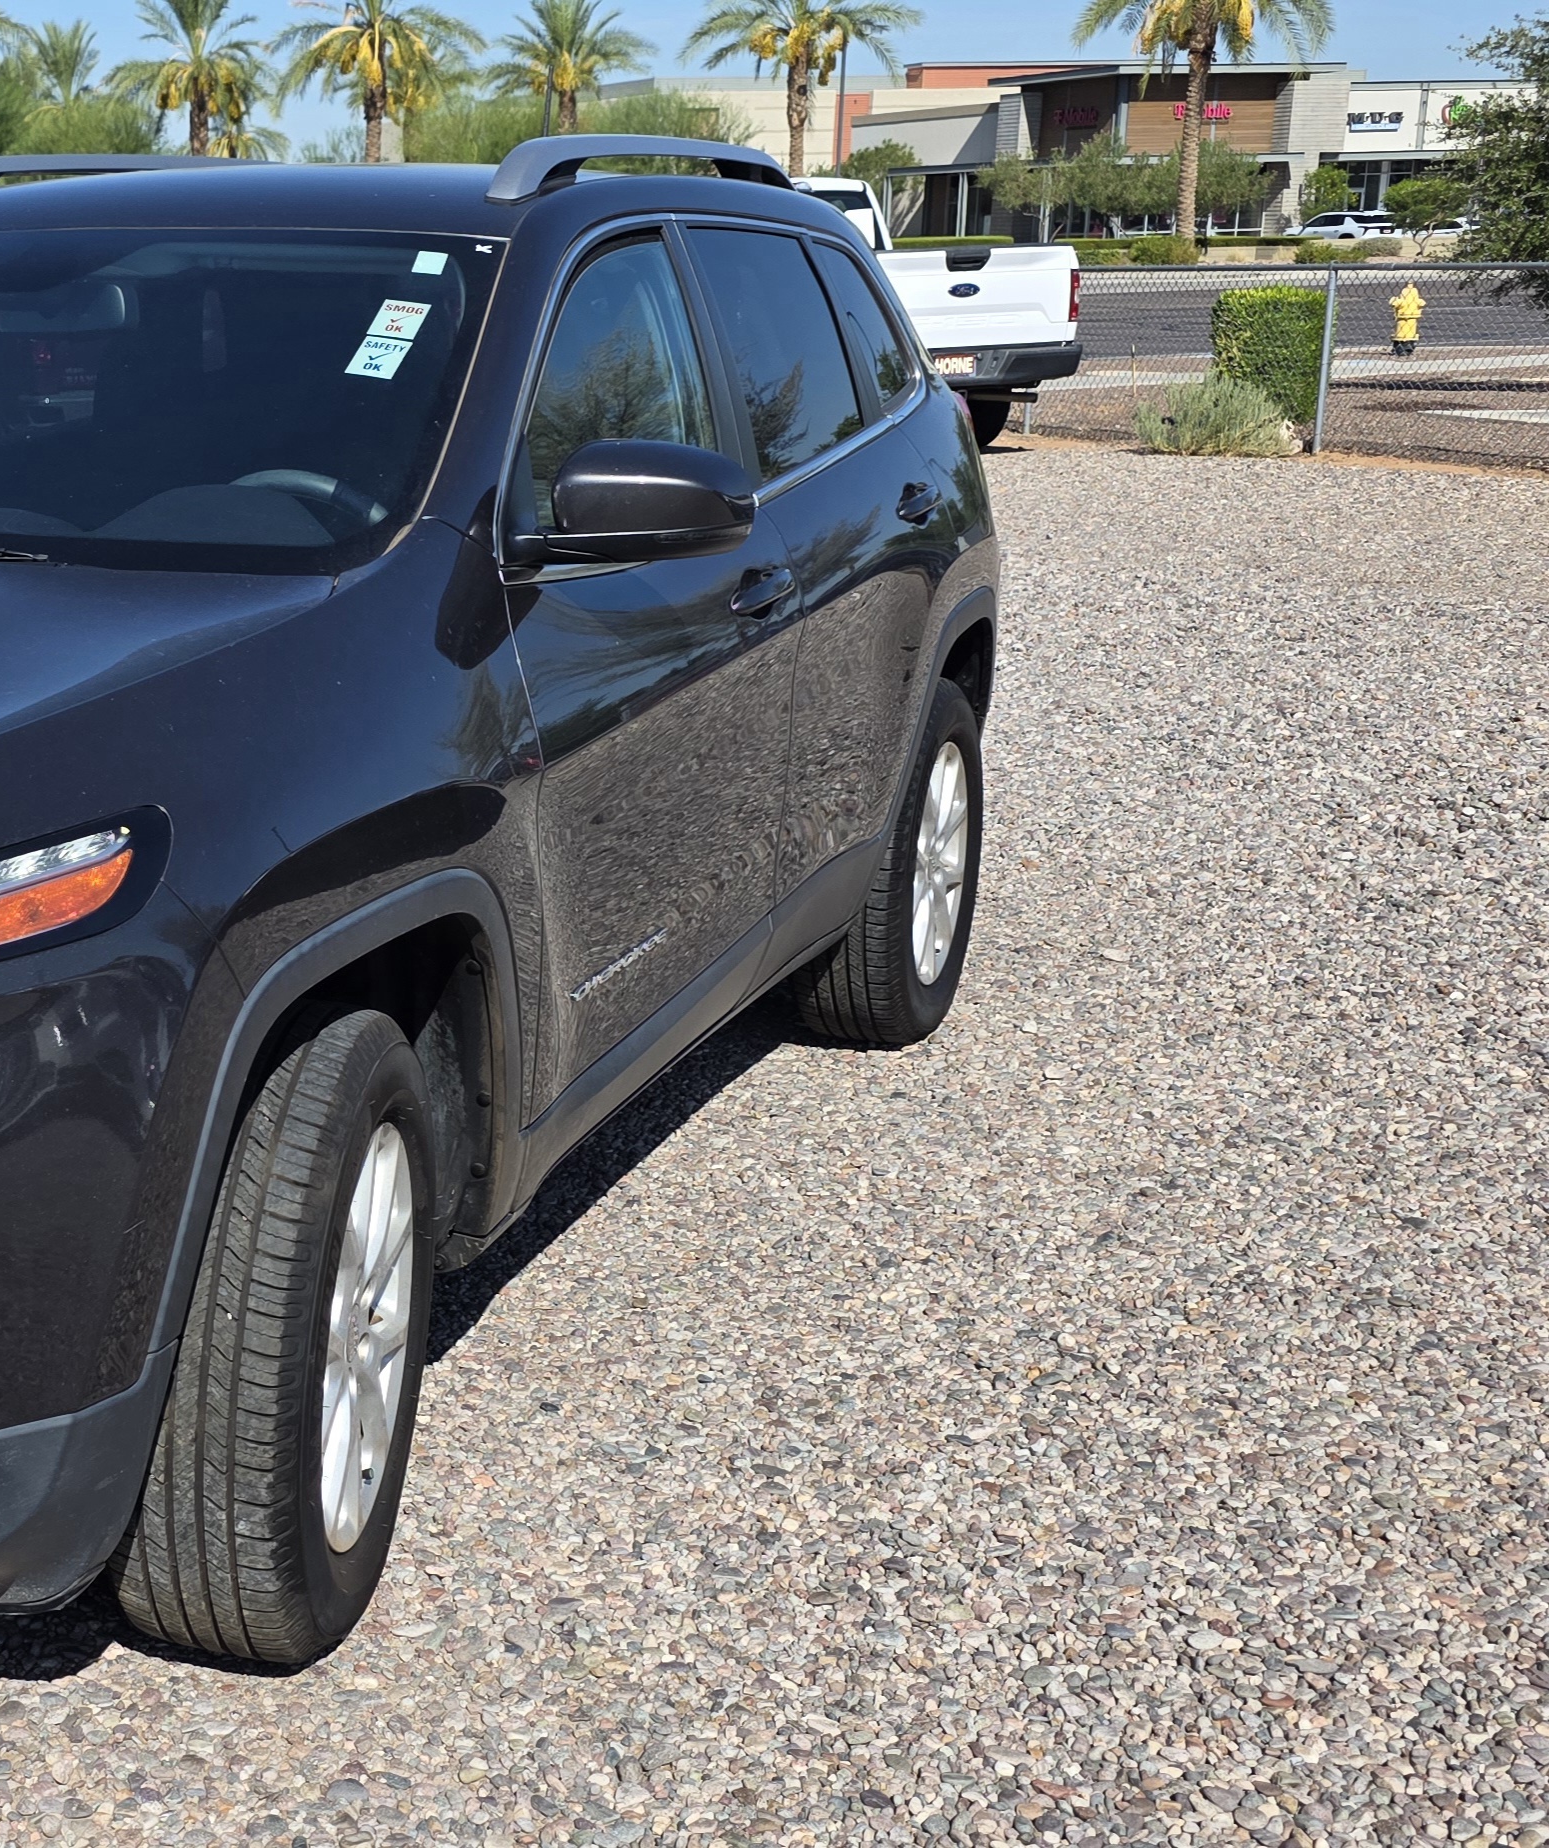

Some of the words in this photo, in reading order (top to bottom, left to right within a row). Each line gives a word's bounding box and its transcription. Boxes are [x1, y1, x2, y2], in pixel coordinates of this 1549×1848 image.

[384, 303, 424, 315] SMOG
[385, 324, 404, 333] OK
[364, 340, 407, 353] SAFETY
[363, 362, 384, 372] OK
[934, 356, 974, 374] HORNE
